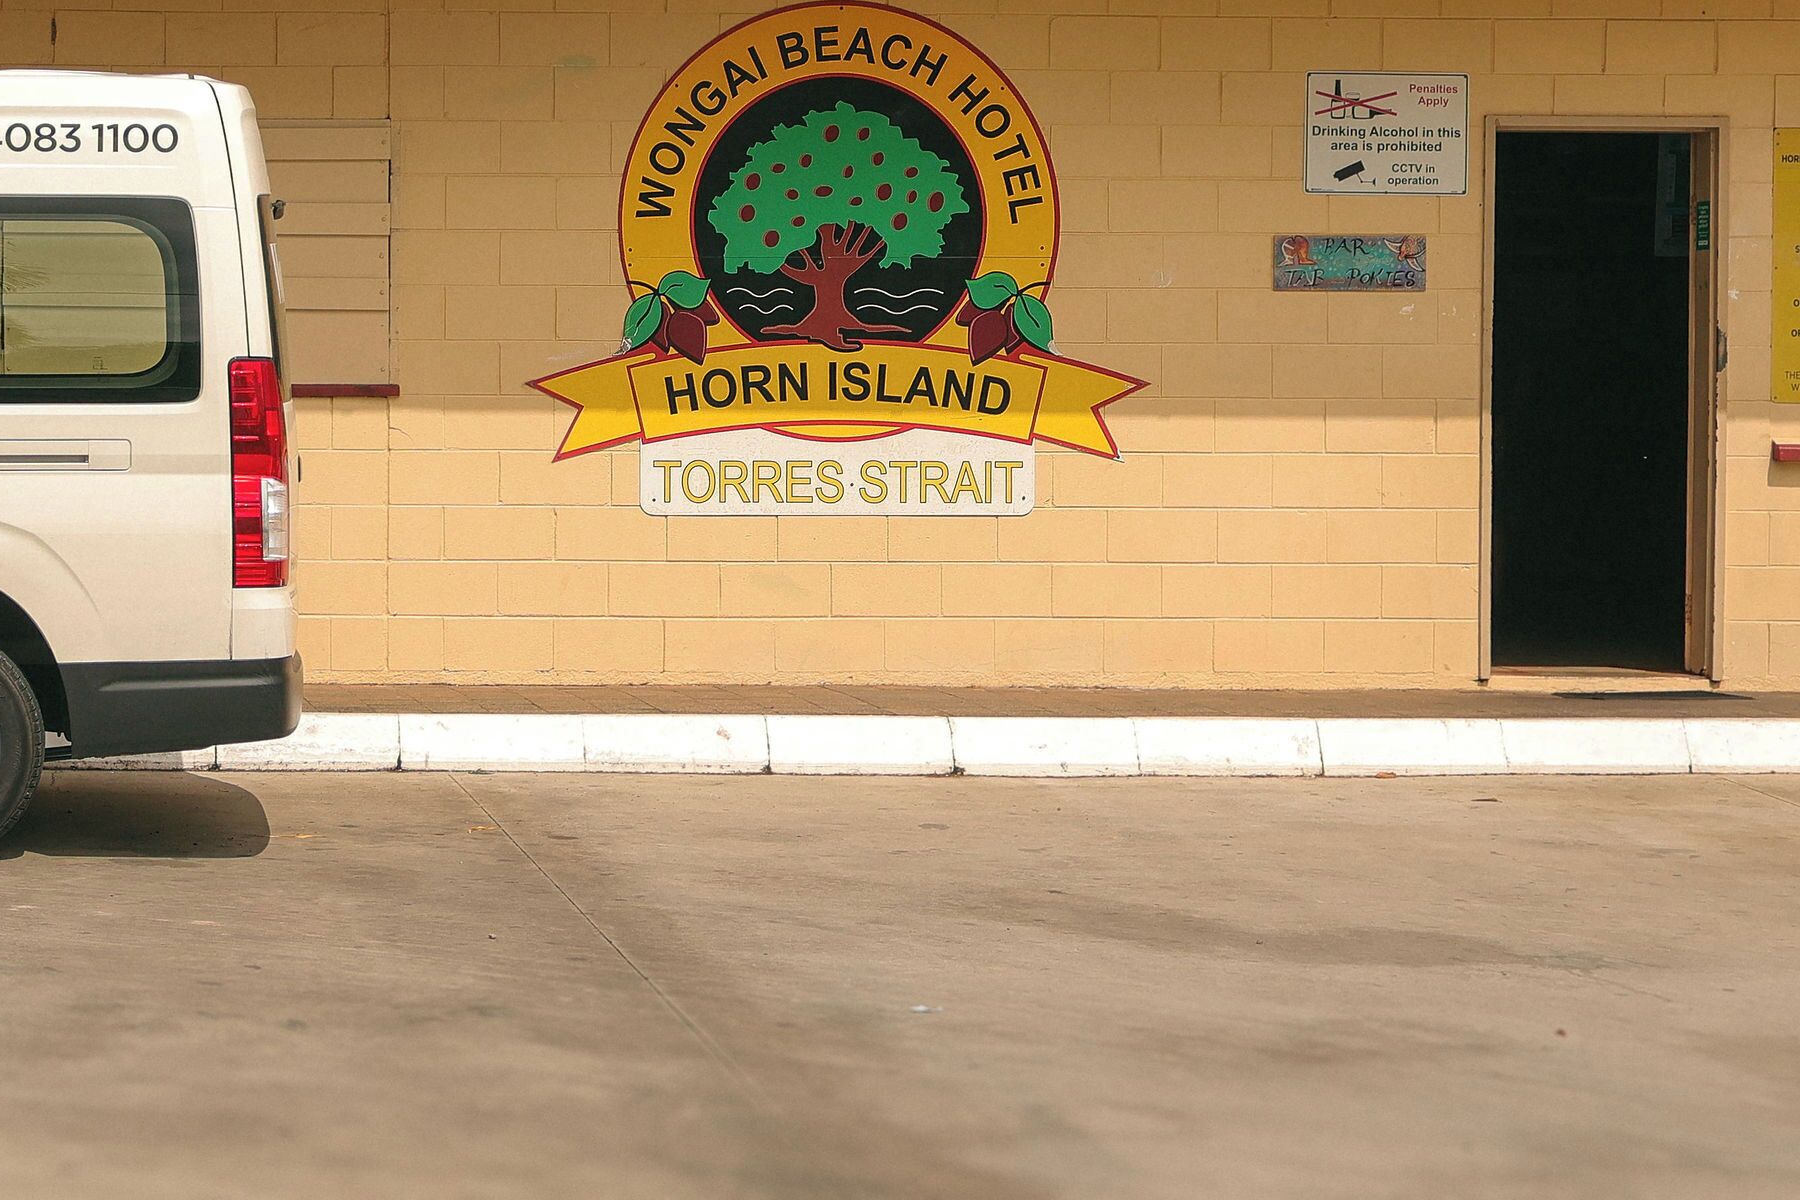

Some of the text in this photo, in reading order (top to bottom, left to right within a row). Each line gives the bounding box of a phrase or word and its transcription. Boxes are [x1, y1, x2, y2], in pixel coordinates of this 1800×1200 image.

[1409, 83, 1458, 93] Penalties
[1417, 96, 1449, 107] Apply
[635, 25, 1045, 225] WONGAI BEACH HOTEL
[91, 123, 179, 153] 1100
[1312, 125, 1461, 139] Drinking Alcohol in this
[1330, 140, 1442, 153] area is prohibited
[1782, 155, 1800, 163] HOR
[1391, 163, 1435, 174] CCTV in
[1387, 176, 1439, 187] operation
[1284, 268, 1416, 287] TAB POKIES
[664, 362, 1013, 415] HORN ISLAND
[653, 459, 1024, 505] TORRES STRAIT
